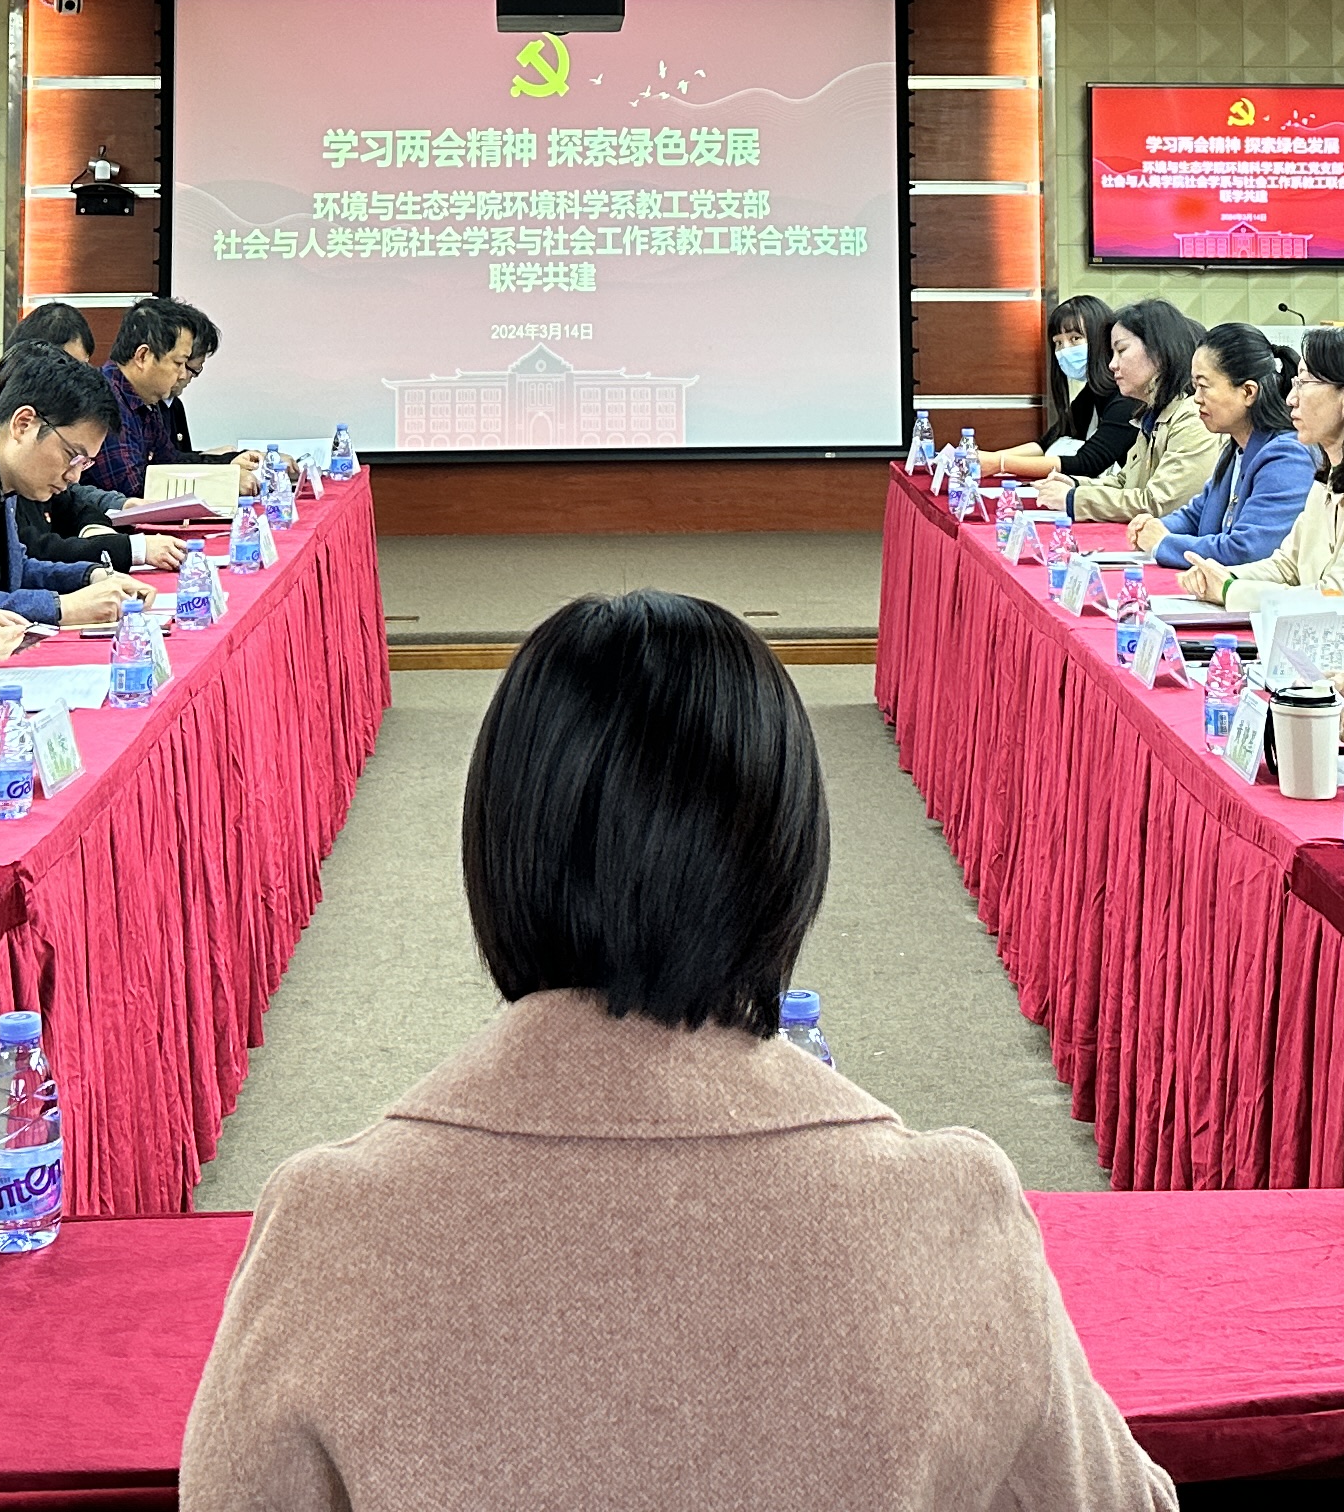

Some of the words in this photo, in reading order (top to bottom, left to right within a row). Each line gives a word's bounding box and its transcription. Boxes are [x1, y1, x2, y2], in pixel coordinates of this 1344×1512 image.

[323, 128, 537, 169] 学习两会精神
[548, 127, 760, 167] 探索绿色发展
[1145, 135, 1241, 155] 学习两会精神
[1244, 136, 1340, 155] 探索绿色发展
[312, 190, 771, 222] 环境与生态学院环境科学系教工党支部
[213, 227, 869, 262] 社会与人类学院社会学系与社会工作系教工联合党支部
[489, 263, 597, 293] 联学共建
[490, 322, 594, 342] 2024年3月14日
